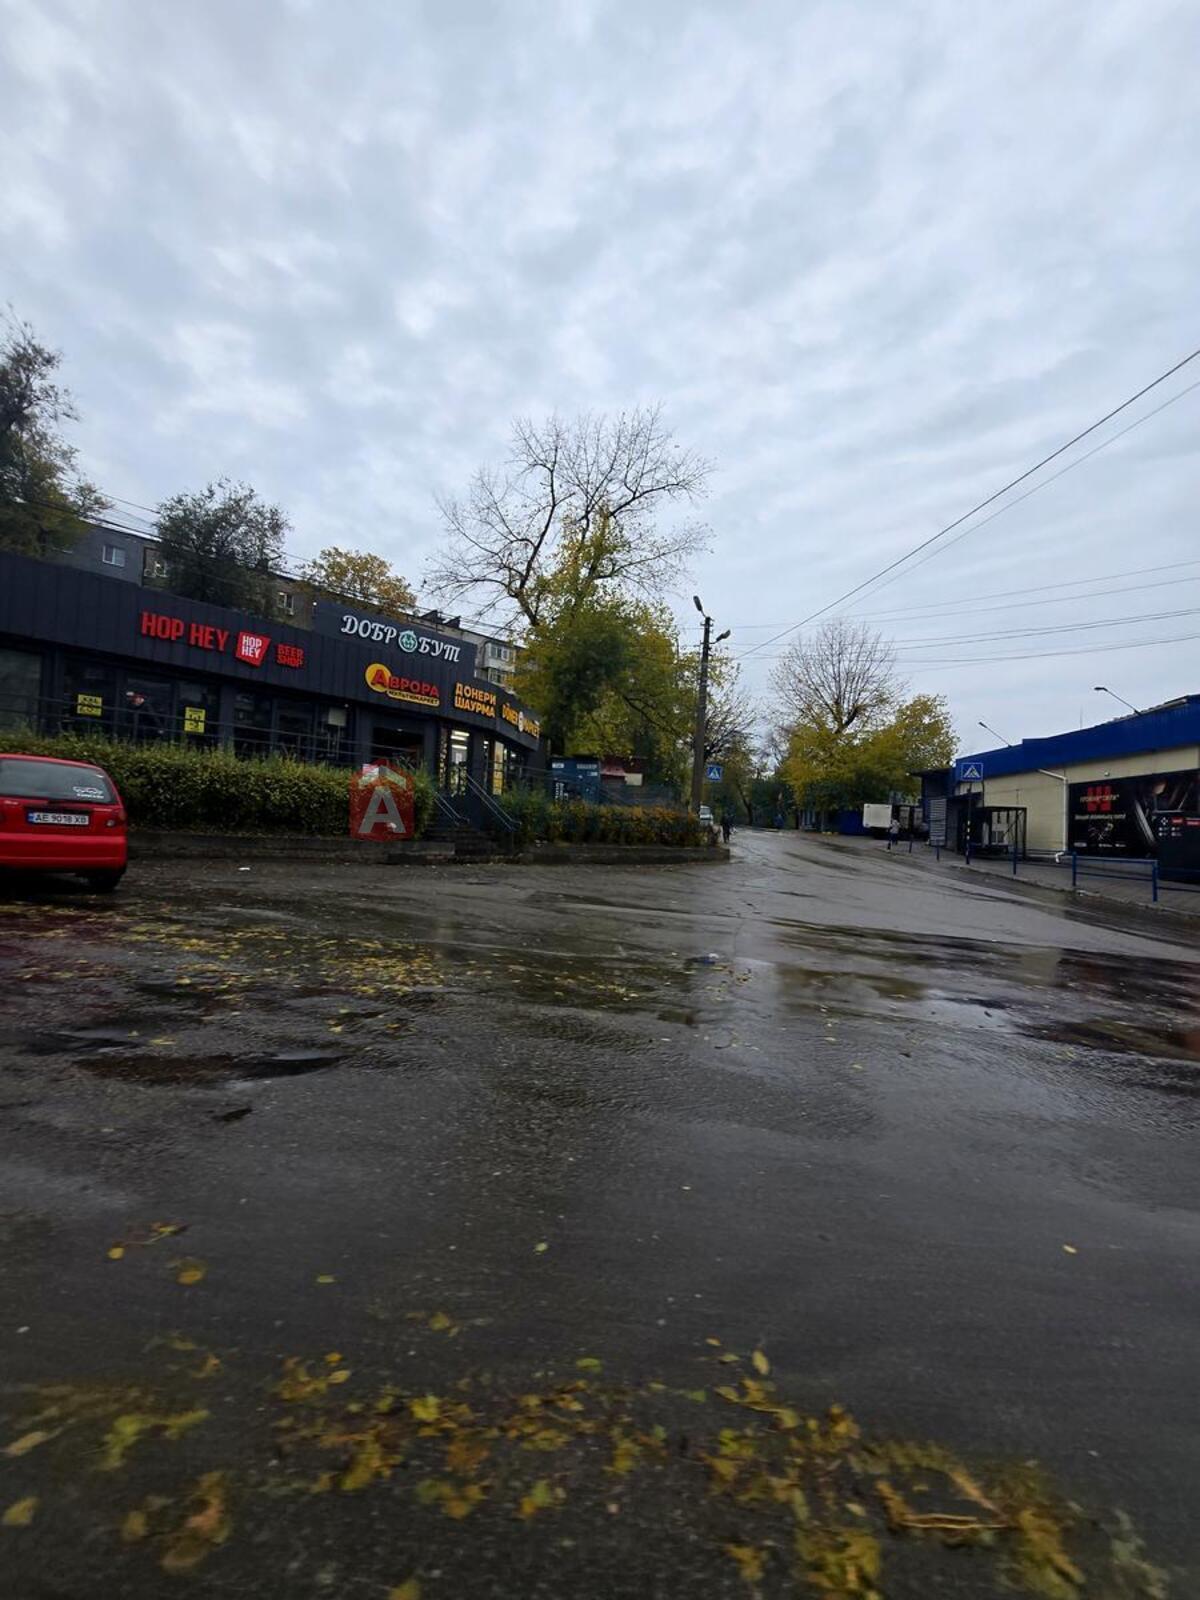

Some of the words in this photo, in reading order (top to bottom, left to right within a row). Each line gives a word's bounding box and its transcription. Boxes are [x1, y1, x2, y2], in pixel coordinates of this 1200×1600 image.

[141, 612, 184, 641] HOP
[190, 623, 230, 651] HEY
[241, 635, 263, 649] HOP
[241, 645, 261, 659] HEY
[370, 668, 441, 698] АВРОРА
[455, 682, 497, 706] ДОНЕРИ
[454, 696, 496, 718] ШАУРМА
[35, 813, 49, 822] AE
